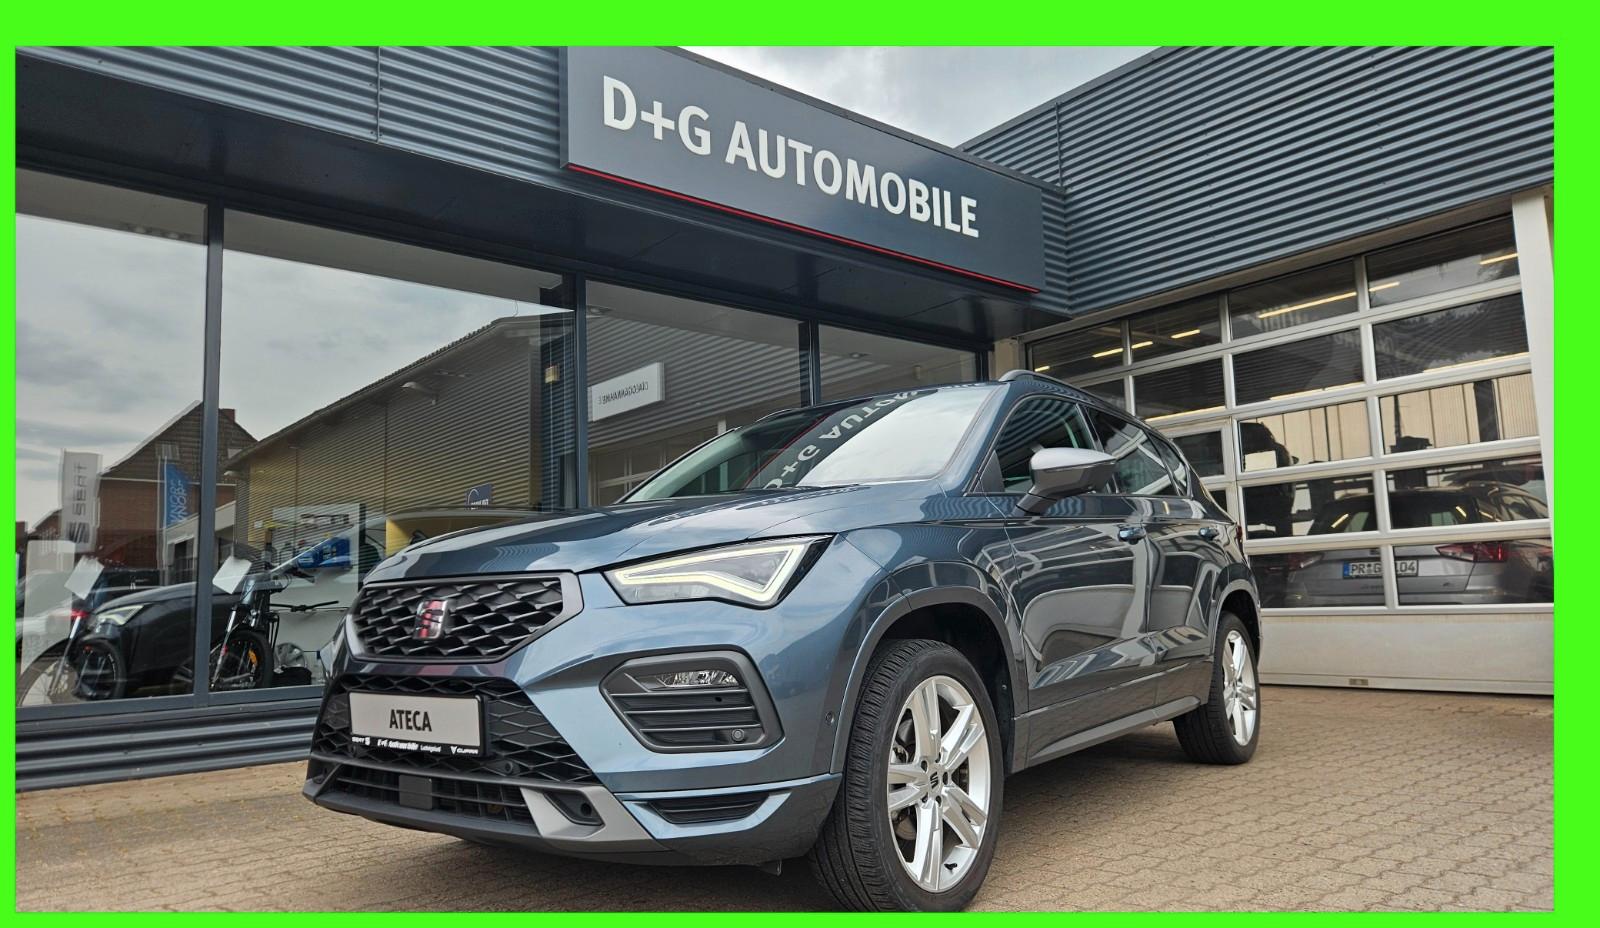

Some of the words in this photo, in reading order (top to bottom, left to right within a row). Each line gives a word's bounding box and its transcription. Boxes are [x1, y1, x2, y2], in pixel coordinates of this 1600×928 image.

[602, 75, 711, 156] D+G
[724, 120, 980, 238] AUTOMOBILE
[389, 709, 432, 732] ATECA
